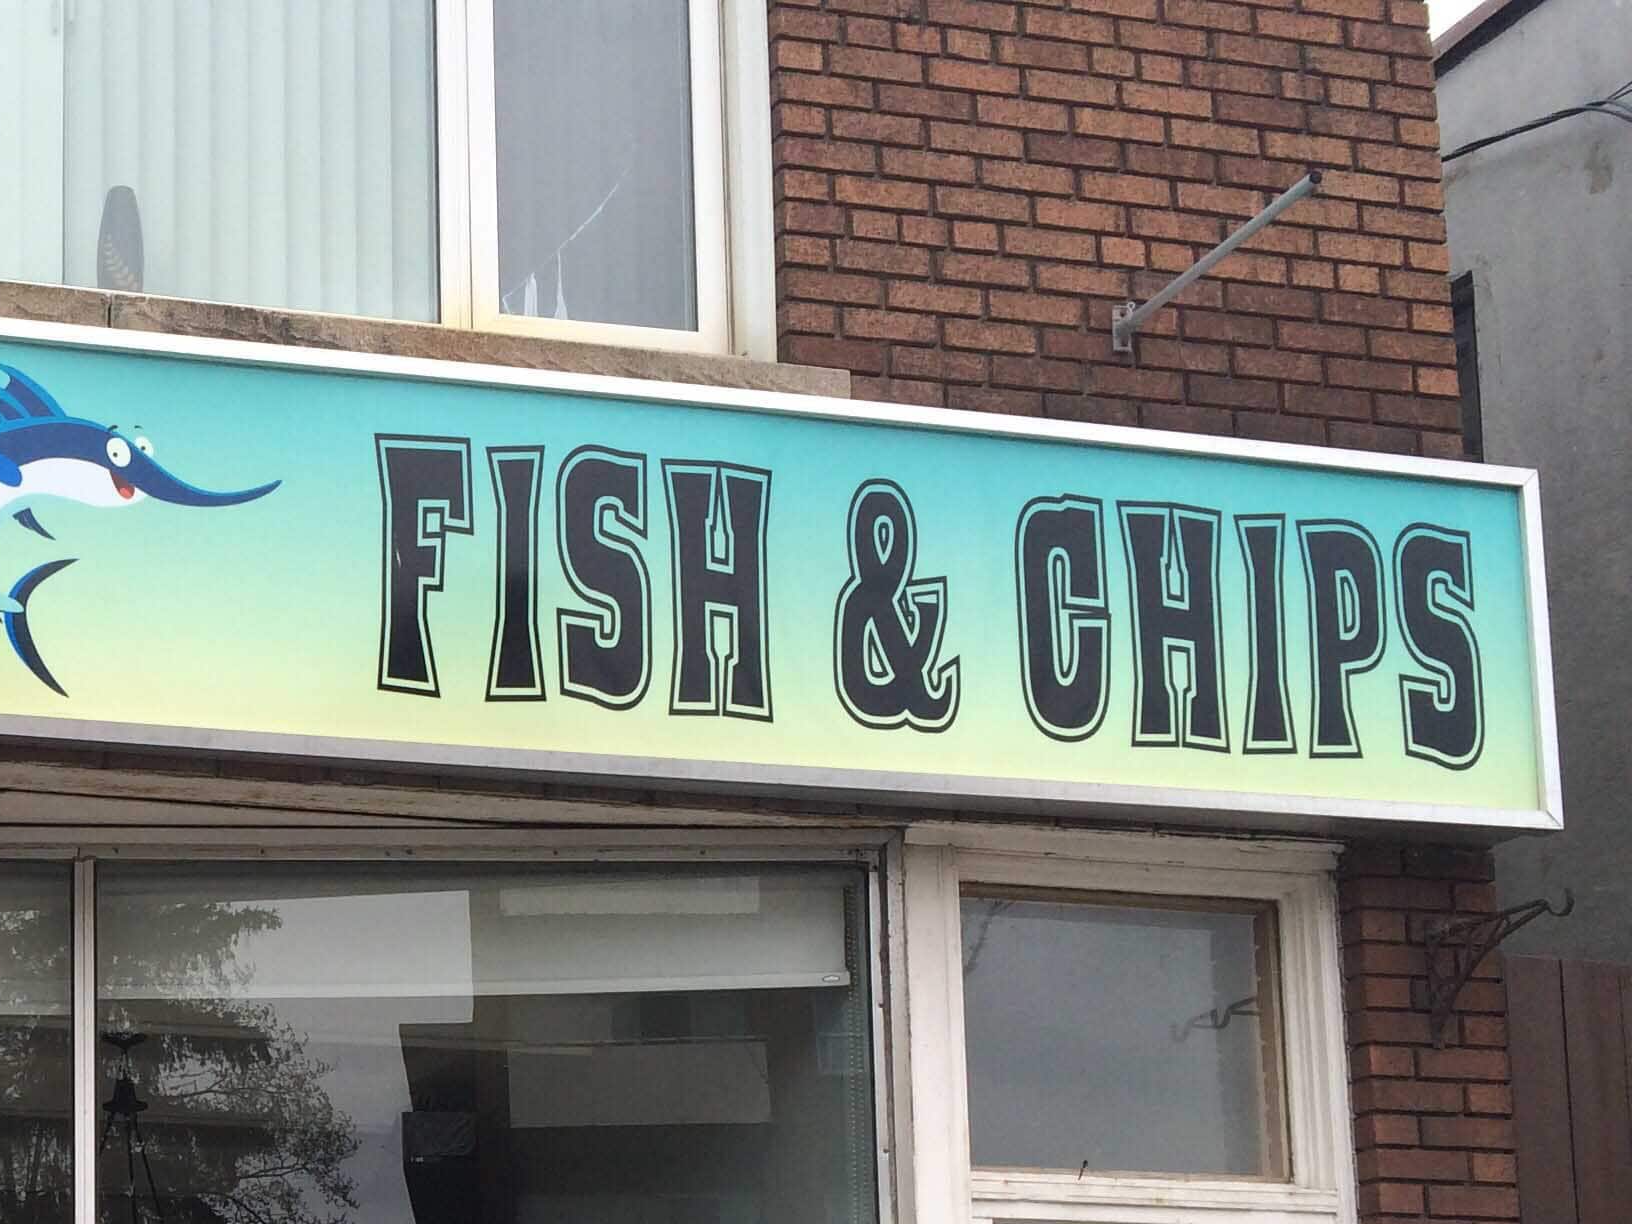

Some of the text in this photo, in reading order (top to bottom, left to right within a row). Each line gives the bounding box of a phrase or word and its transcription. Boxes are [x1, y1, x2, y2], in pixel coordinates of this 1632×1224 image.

[374, 432, 774, 723] FISH
[833, 478, 961, 734] &
[1014, 492, 1486, 771] CHIPS
